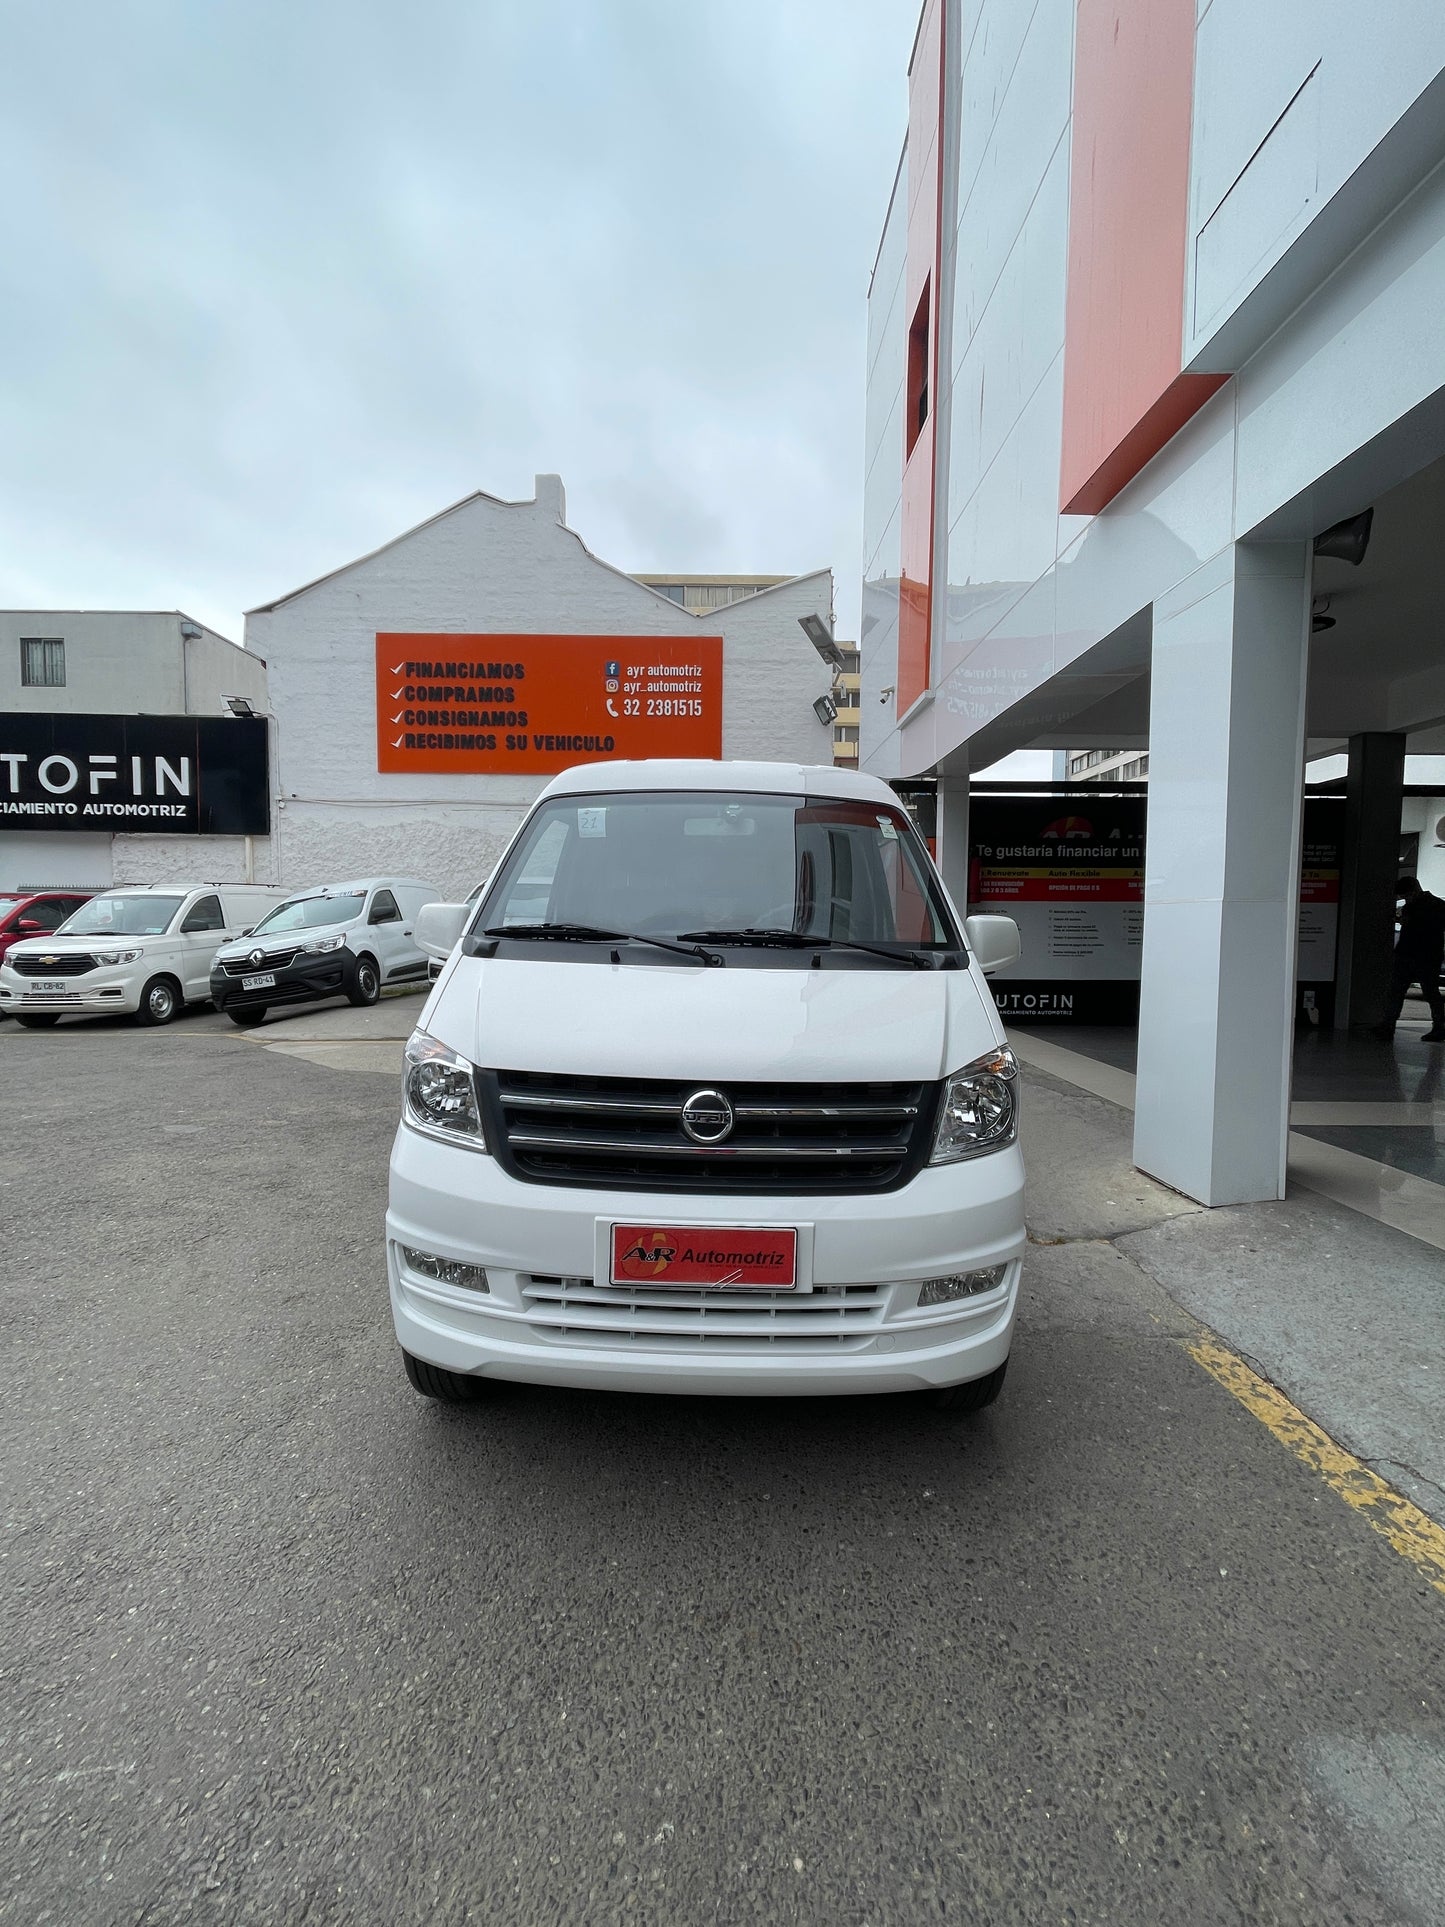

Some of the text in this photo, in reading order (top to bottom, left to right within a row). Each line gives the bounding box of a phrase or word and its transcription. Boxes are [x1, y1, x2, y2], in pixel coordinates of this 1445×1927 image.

[405, 662, 525, 679] FINANCIAMOS
[627, 664, 702, 678] ayr automotriz
[404, 686, 515, 703] COMPRAMOS
[624, 680, 702, 693] ayr_automotriz
[624, 699, 702, 716] 32 2381515
[404, 710, 528, 727] CONSIGNAMOS
[405, 734, 615, 752] RECIBIMOS SU VEHICULO
[83, 803, 187, 817] AUTOMOTRIZ
[976, 844, 1139, 859] Te gustaría financiar un
[243, 979, 253, 987] SS
[996, 994, 1073, 1008] UTOFIN
[681, 1248, 785, 1265] Automotriz
